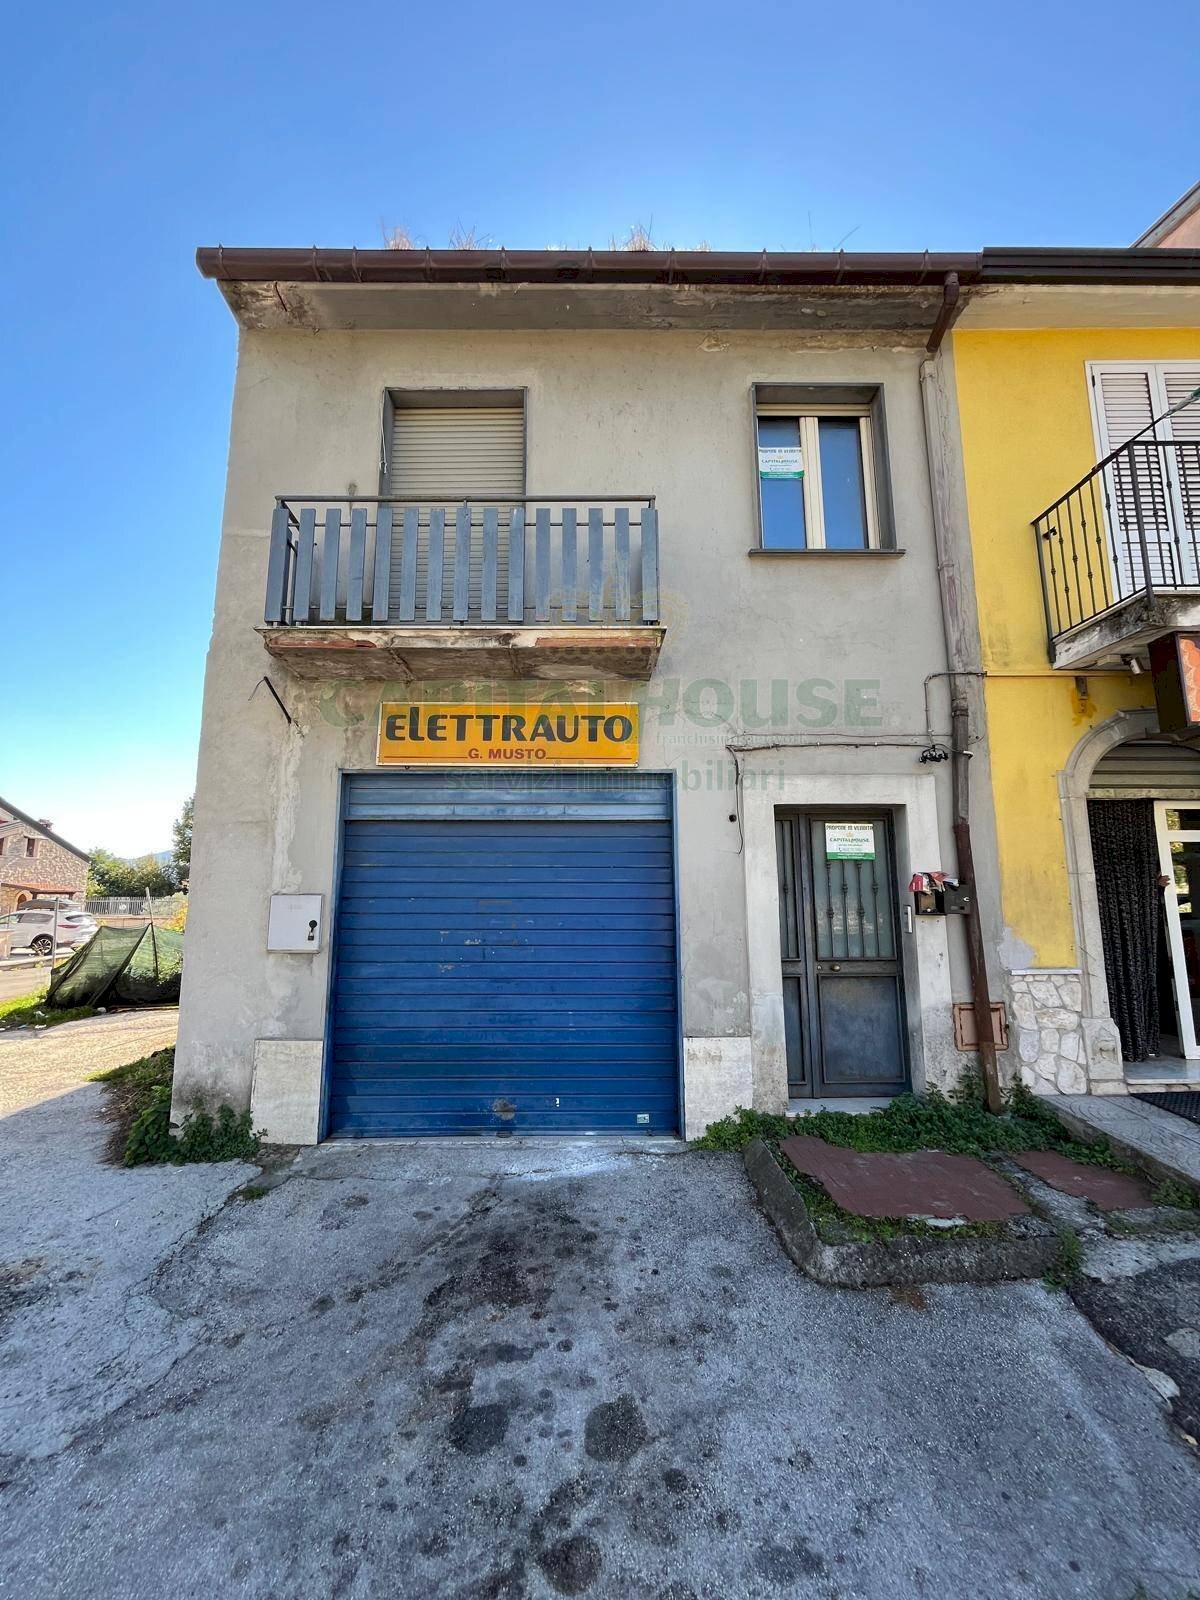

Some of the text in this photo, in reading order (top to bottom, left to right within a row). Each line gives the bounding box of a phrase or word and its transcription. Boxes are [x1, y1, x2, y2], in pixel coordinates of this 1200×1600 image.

[385, 706, 634, 744] ELETTRAUTO
[468, 748, 547, 760] G. MUSTO
